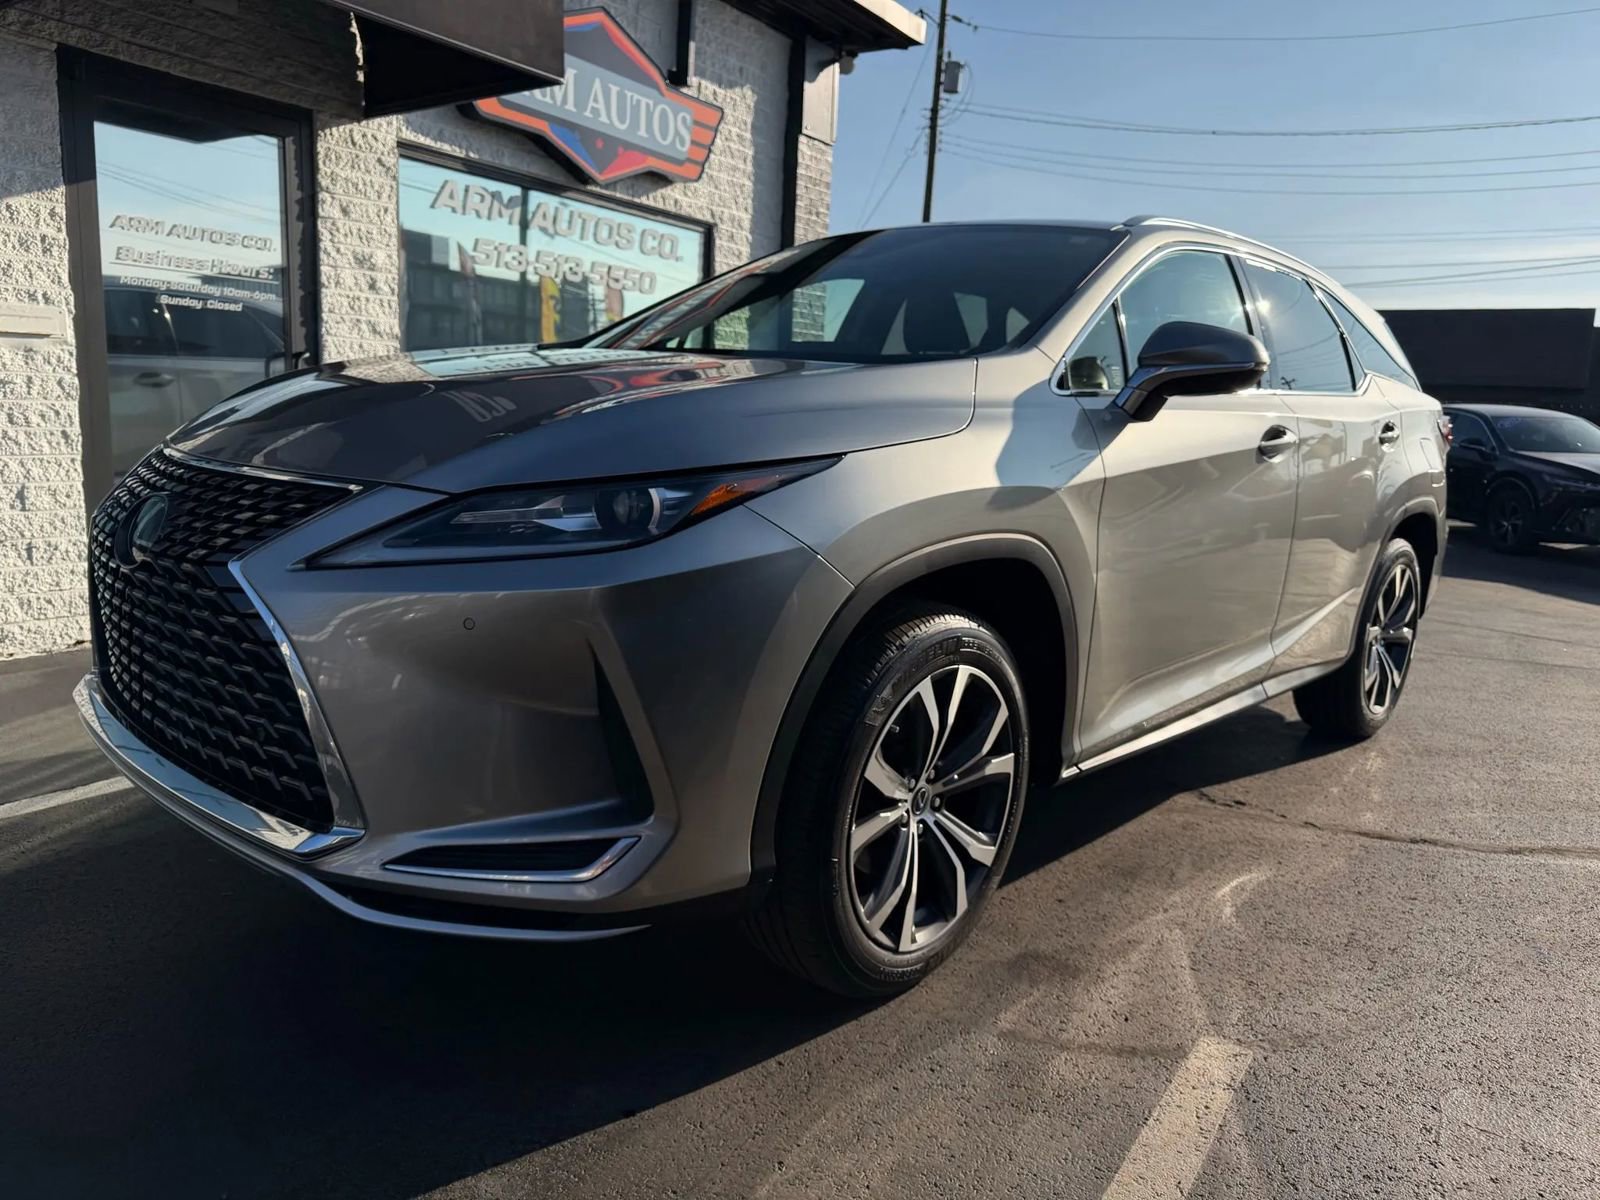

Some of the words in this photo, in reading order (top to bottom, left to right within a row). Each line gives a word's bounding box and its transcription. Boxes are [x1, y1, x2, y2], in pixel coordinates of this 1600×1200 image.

[584, 78, 692, 151] AUTOS
[109, 215, 165, 235] ARM
[166, 224, 241, 246] AUTOS
[430, 179, 521, 225] ARM
[528, 202, 637, 250] AUTOS
[639, 228, 684, 261] CO.
[115, 246, 209, 271] Business
[210, 259, 275, 279] Hours:
[159, 294, 203, 309] Sunday
[207, 299, 244, 311] Closed
